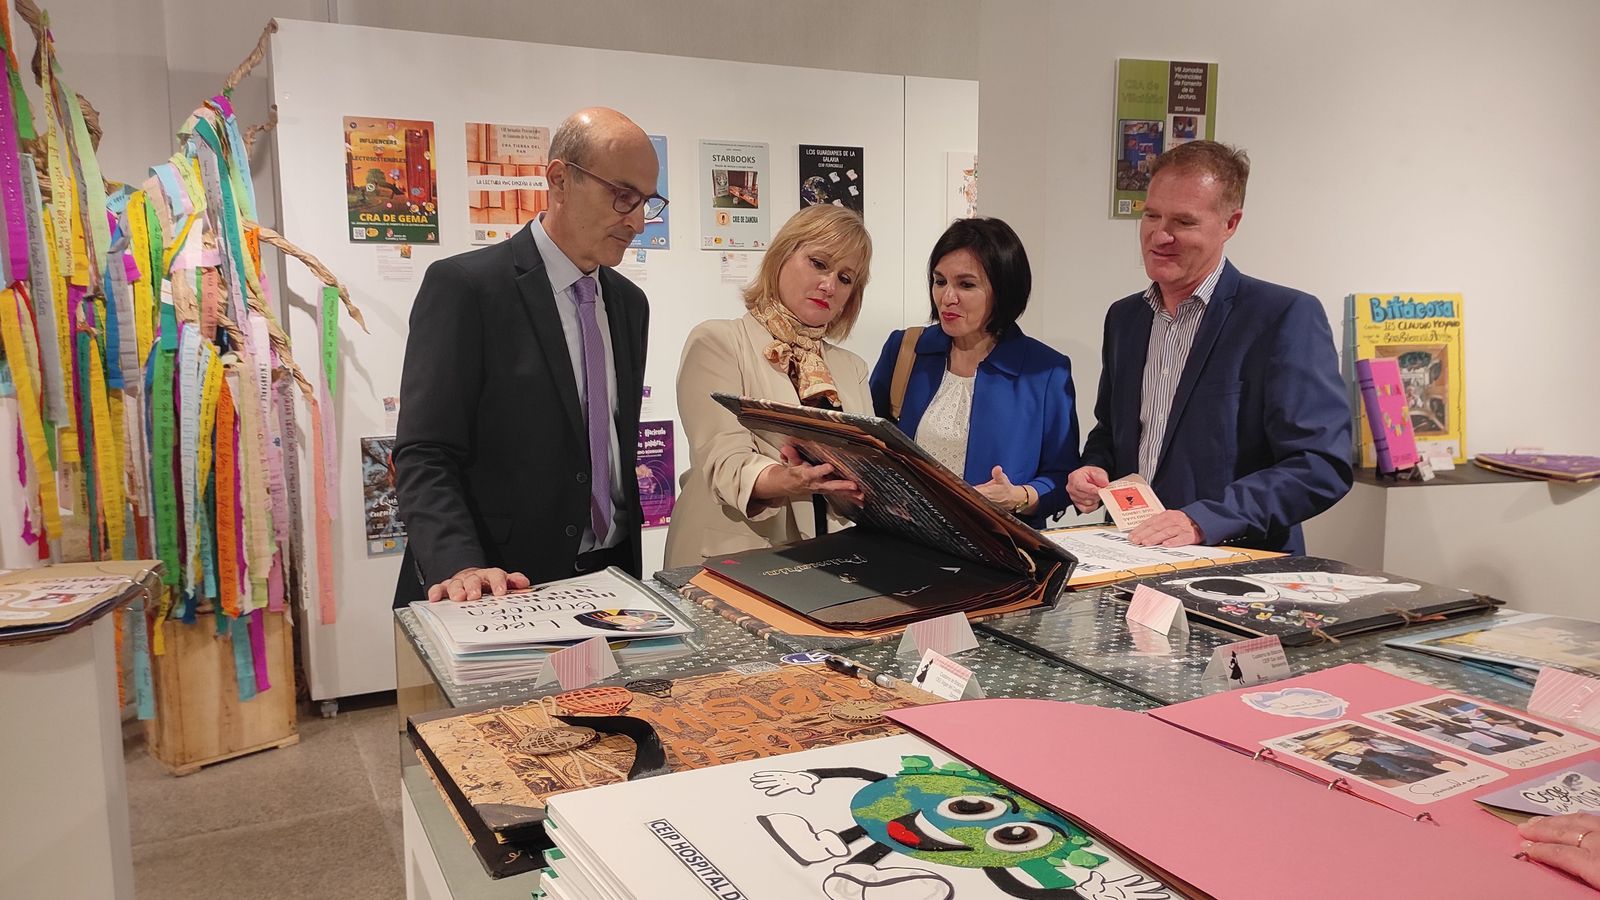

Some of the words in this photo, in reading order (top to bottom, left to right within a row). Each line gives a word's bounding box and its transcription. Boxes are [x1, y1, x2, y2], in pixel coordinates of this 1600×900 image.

[712, 155, 755, 163] STARBOOKS
[359, 213, 380, 222] CRA
[383, 214, 396, 222] DE
[398, 214, 428, 223] GEMA
[1370, 296, 1454, 322] Bitácora
[1398, 321, 1431, 330] CLAUDIO
[476, 619, 560, 633] LIBRO
[650, 820, 681, 841] CEIP
[671, 842, 730, 892] HOSPITAL
